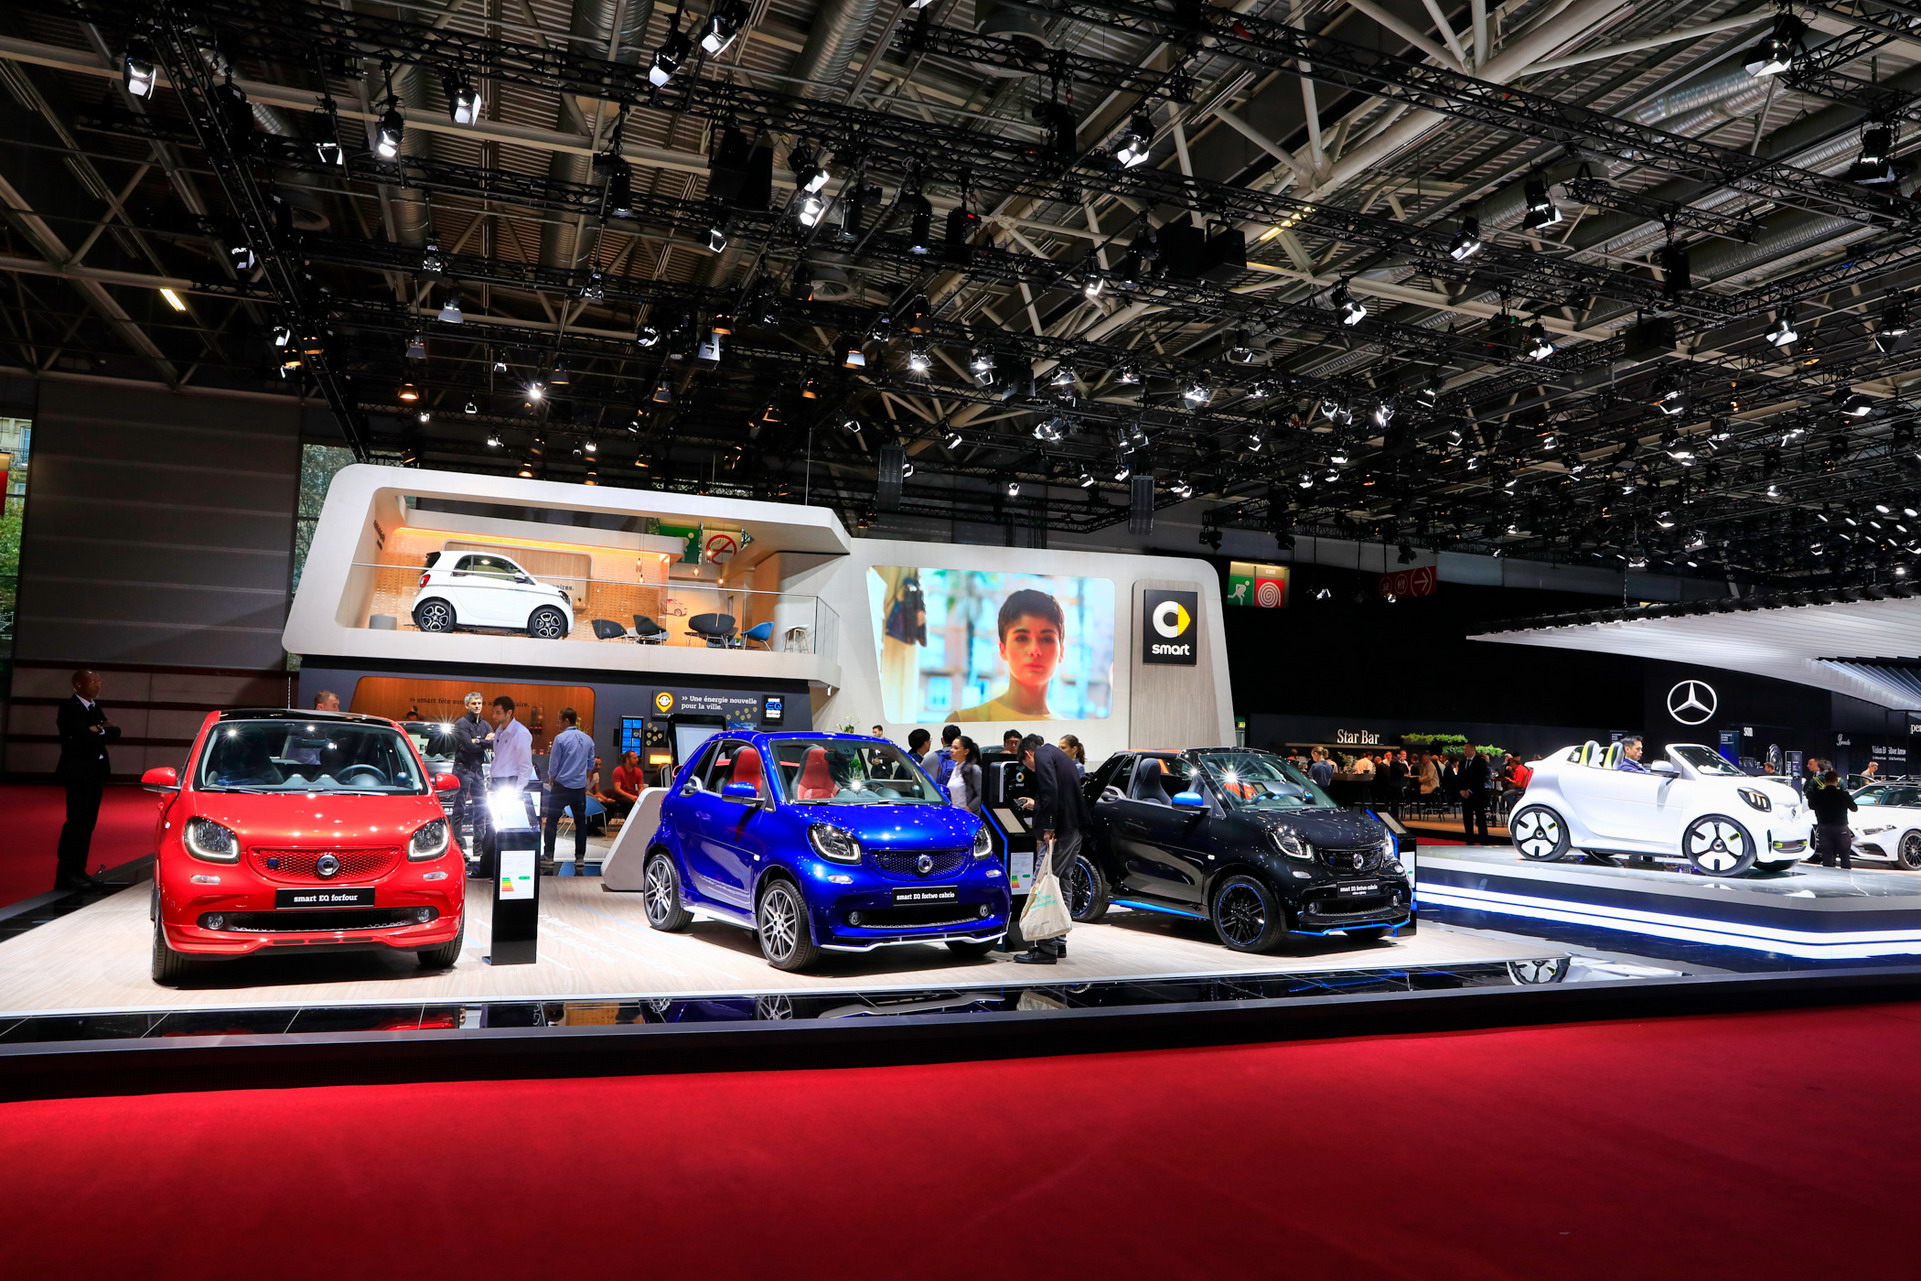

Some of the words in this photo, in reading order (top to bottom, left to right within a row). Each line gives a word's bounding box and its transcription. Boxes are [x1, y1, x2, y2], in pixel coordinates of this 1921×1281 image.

[1151, 643, 1190, 656] smart
[704, 696, 729, 704] énergie
[729, 697, 757, 705] nouvelle
[765, 701, 782, 711] EQ
[1336, 728, 1360, 744] Star
[1360, 729, 1380, 745] Bar
[293, 895, 317, 903] smart
[318, 894, 330, 902] EQ
[331, 893, 359, 902] forfour
